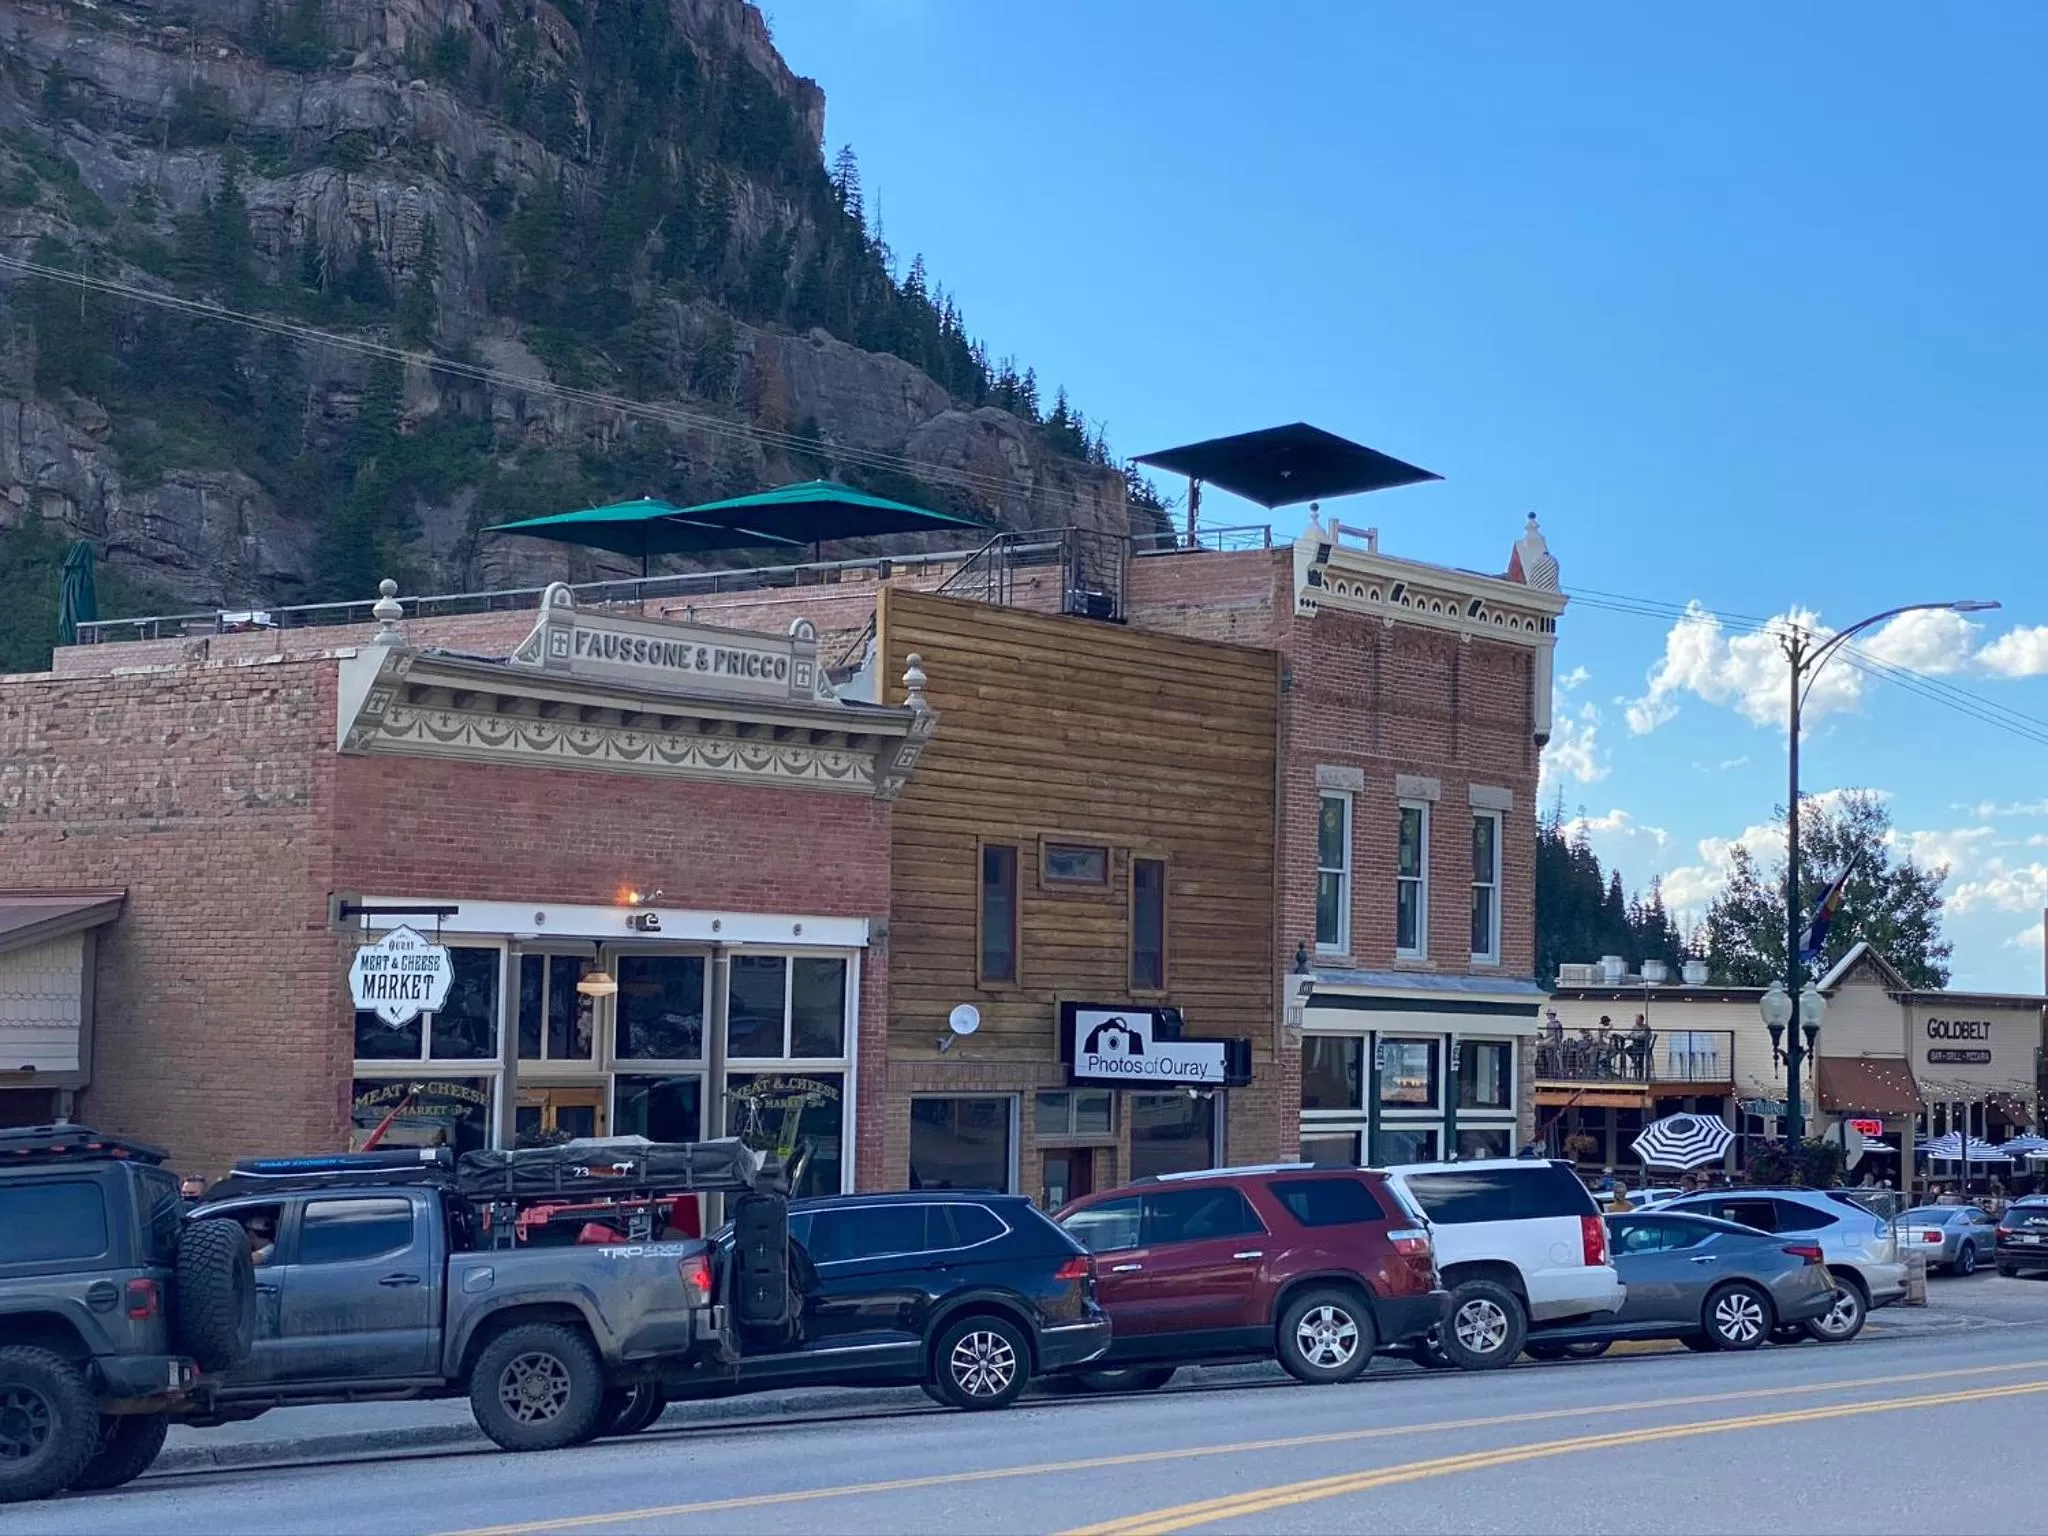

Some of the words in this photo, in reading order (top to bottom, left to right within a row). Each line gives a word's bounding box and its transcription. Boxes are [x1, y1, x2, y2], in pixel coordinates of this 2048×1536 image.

[575, 630, 692, 669] FAUSSONE
[696, 648, 709, 671] &
[714, 649, 787, 681] PRICCO
[361, 955, 390, 971] MEAT
[391, 957, 399, 969] &
[401, 955, 440, 971] CHEESE
[362, 974, 434, 999] MARKET
[1928, 1017, 1991, 1040] GOLDBELT
[1088, 1056, 1143, 1073] Photos
[1144, 1056, 1159, 1074] of
[1160, 1058, 1208, 1079] Ouray
[355, 1084, 403, 1109] MEAT
[428, 1082, 491, 1106] CHEESE
[728, 1080, 770, 1102] MEAT
[598, 1246, 643, 1259] TRD
